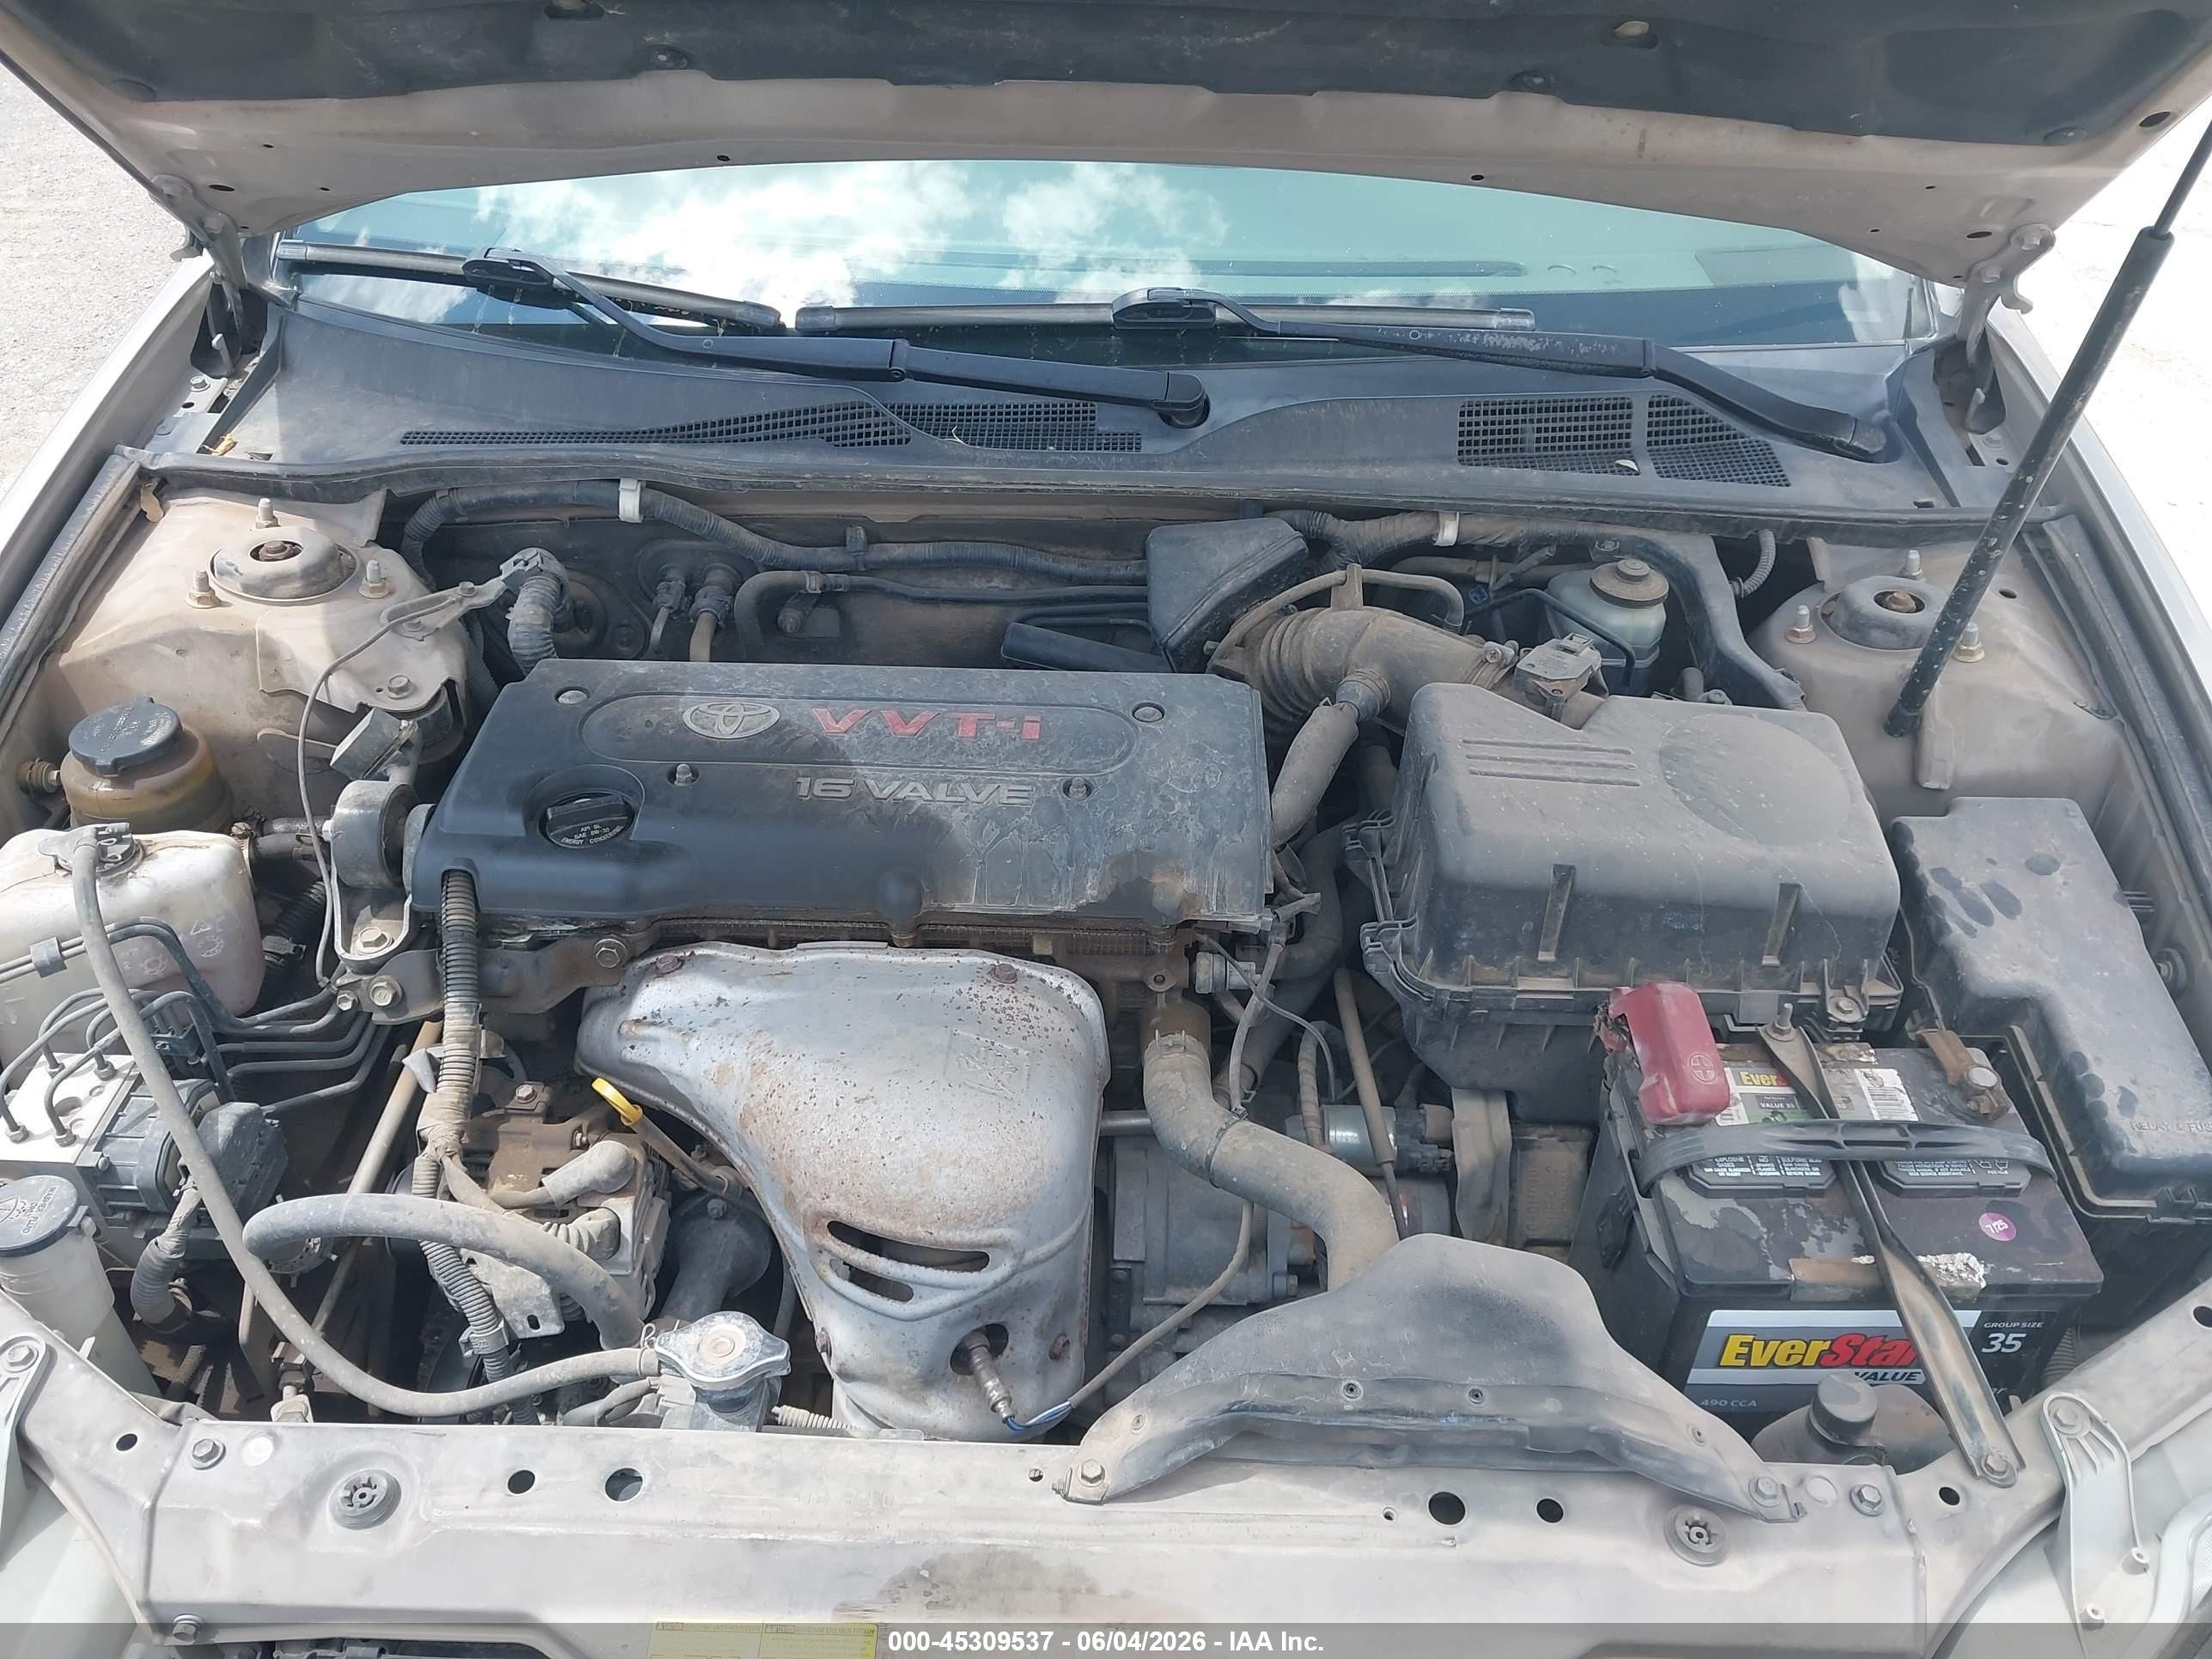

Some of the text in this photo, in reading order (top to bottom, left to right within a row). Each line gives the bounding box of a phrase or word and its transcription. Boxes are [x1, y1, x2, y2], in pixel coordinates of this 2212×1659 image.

[811, 708, 1042, 742] VVT-i
[796, 776, 1033, 807] 16 VALVE
[1985, 1219, 2009, 1234] 7/25
[1981, 1333, 2027, 1353] 35
[1700, 1399, 1757, 1408] 490 CCA
